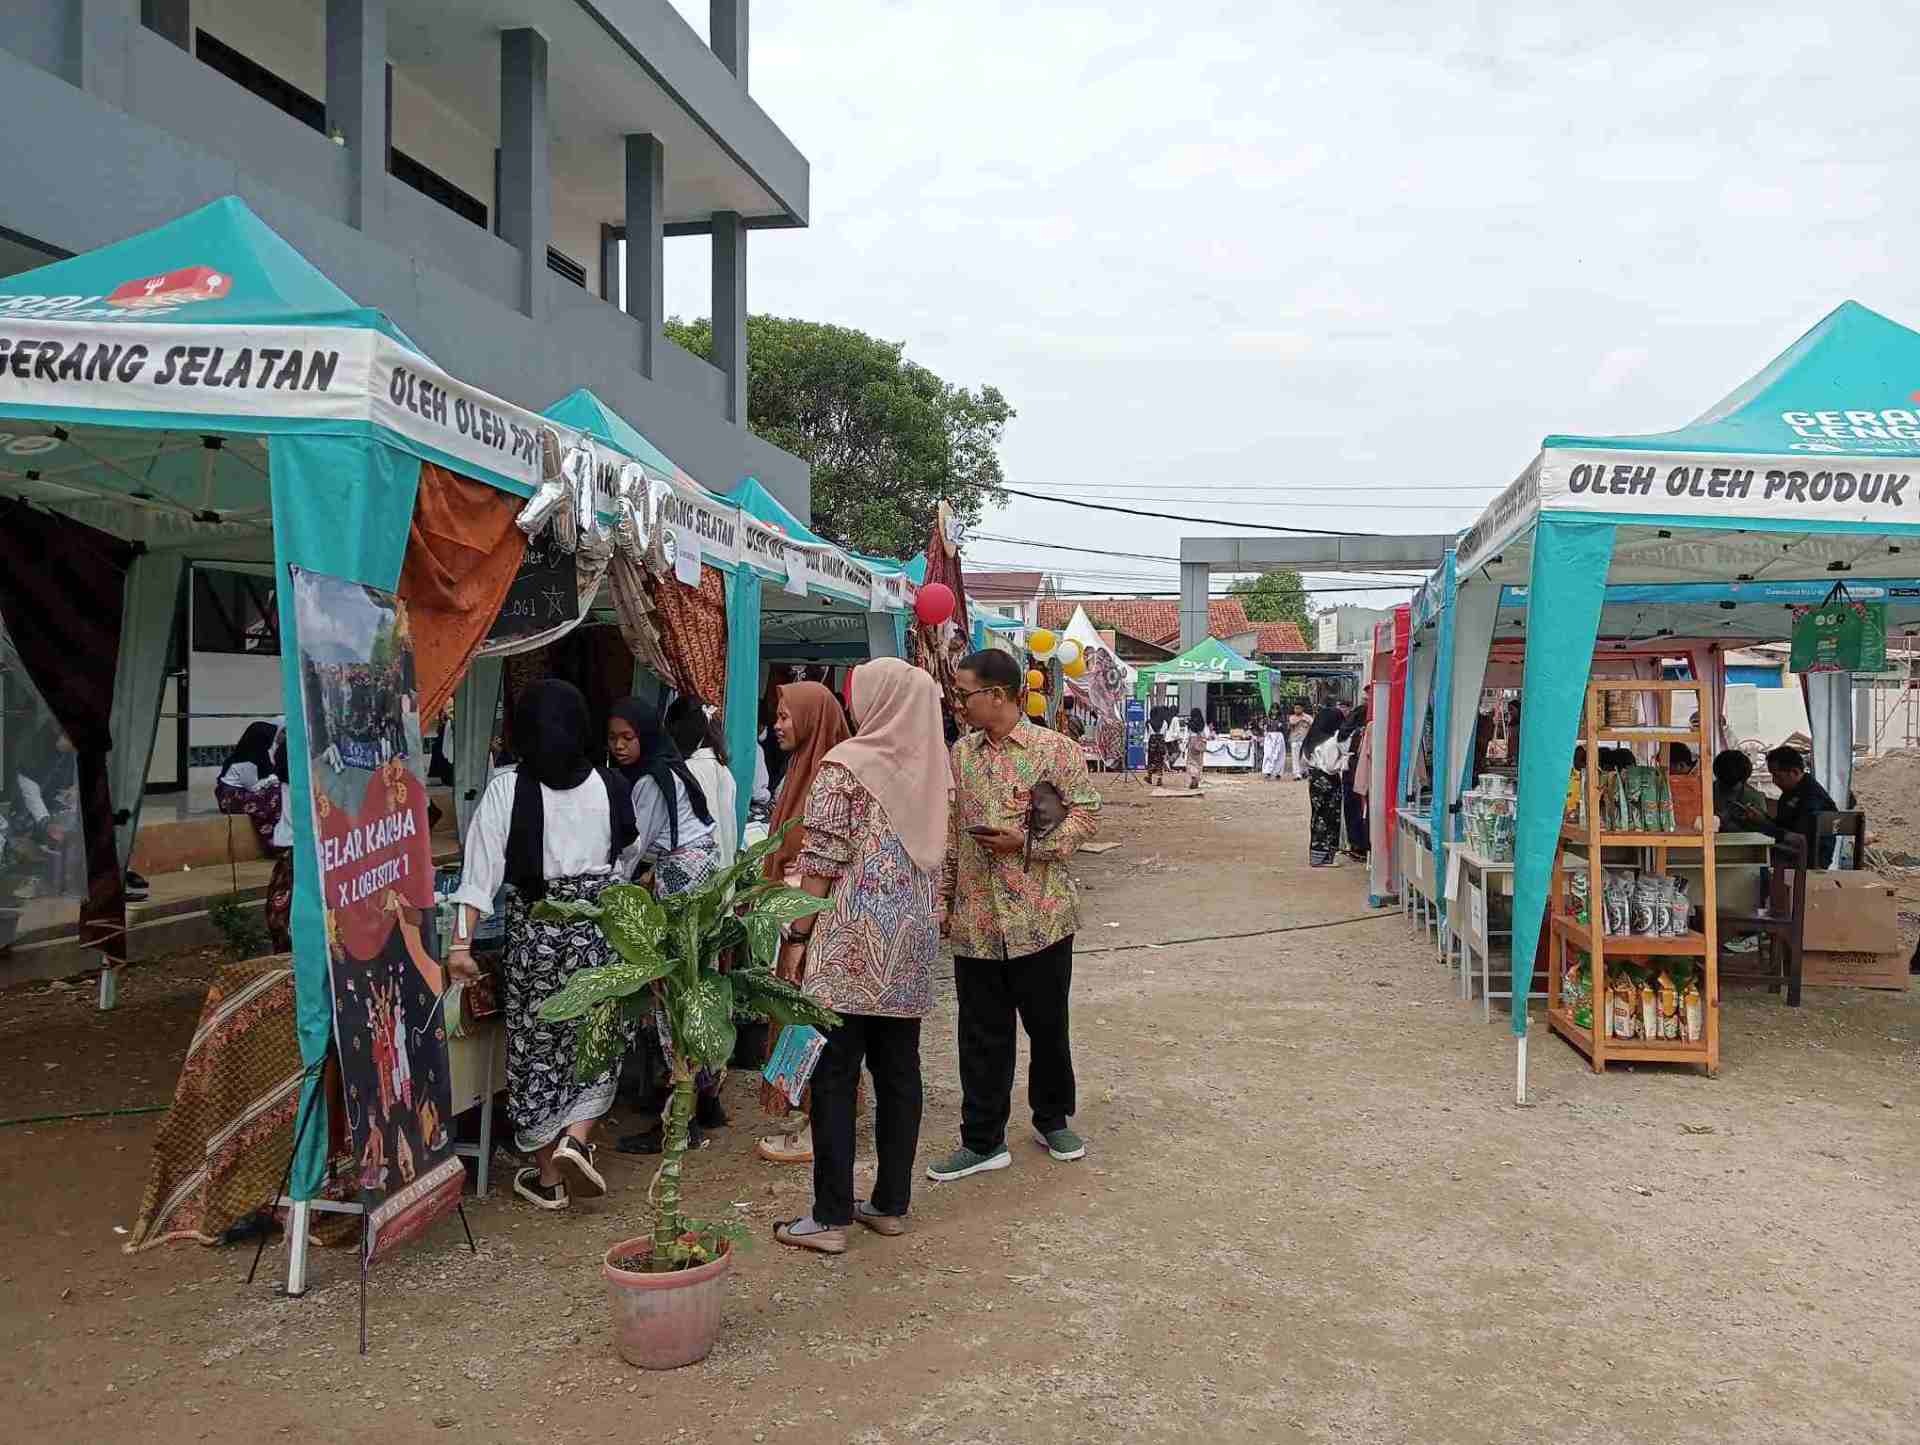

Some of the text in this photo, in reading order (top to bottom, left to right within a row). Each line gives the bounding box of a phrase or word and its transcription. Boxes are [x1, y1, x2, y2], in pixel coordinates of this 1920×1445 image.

[154, 346, 339, 391] SELATAN
[1781, 409, 1920, 427] GERA
[390, 366, 448, 426] OLEH
[454, 398, 506, 450] OLEH
[695, 508, 735, 547] SELATAN
[1568, 463, 1911, 506] OLEH OLEH PRODUK
[366, 808, 416, 853] KARYA
[339, 853, 409, 907] X LOGISTIK 1
